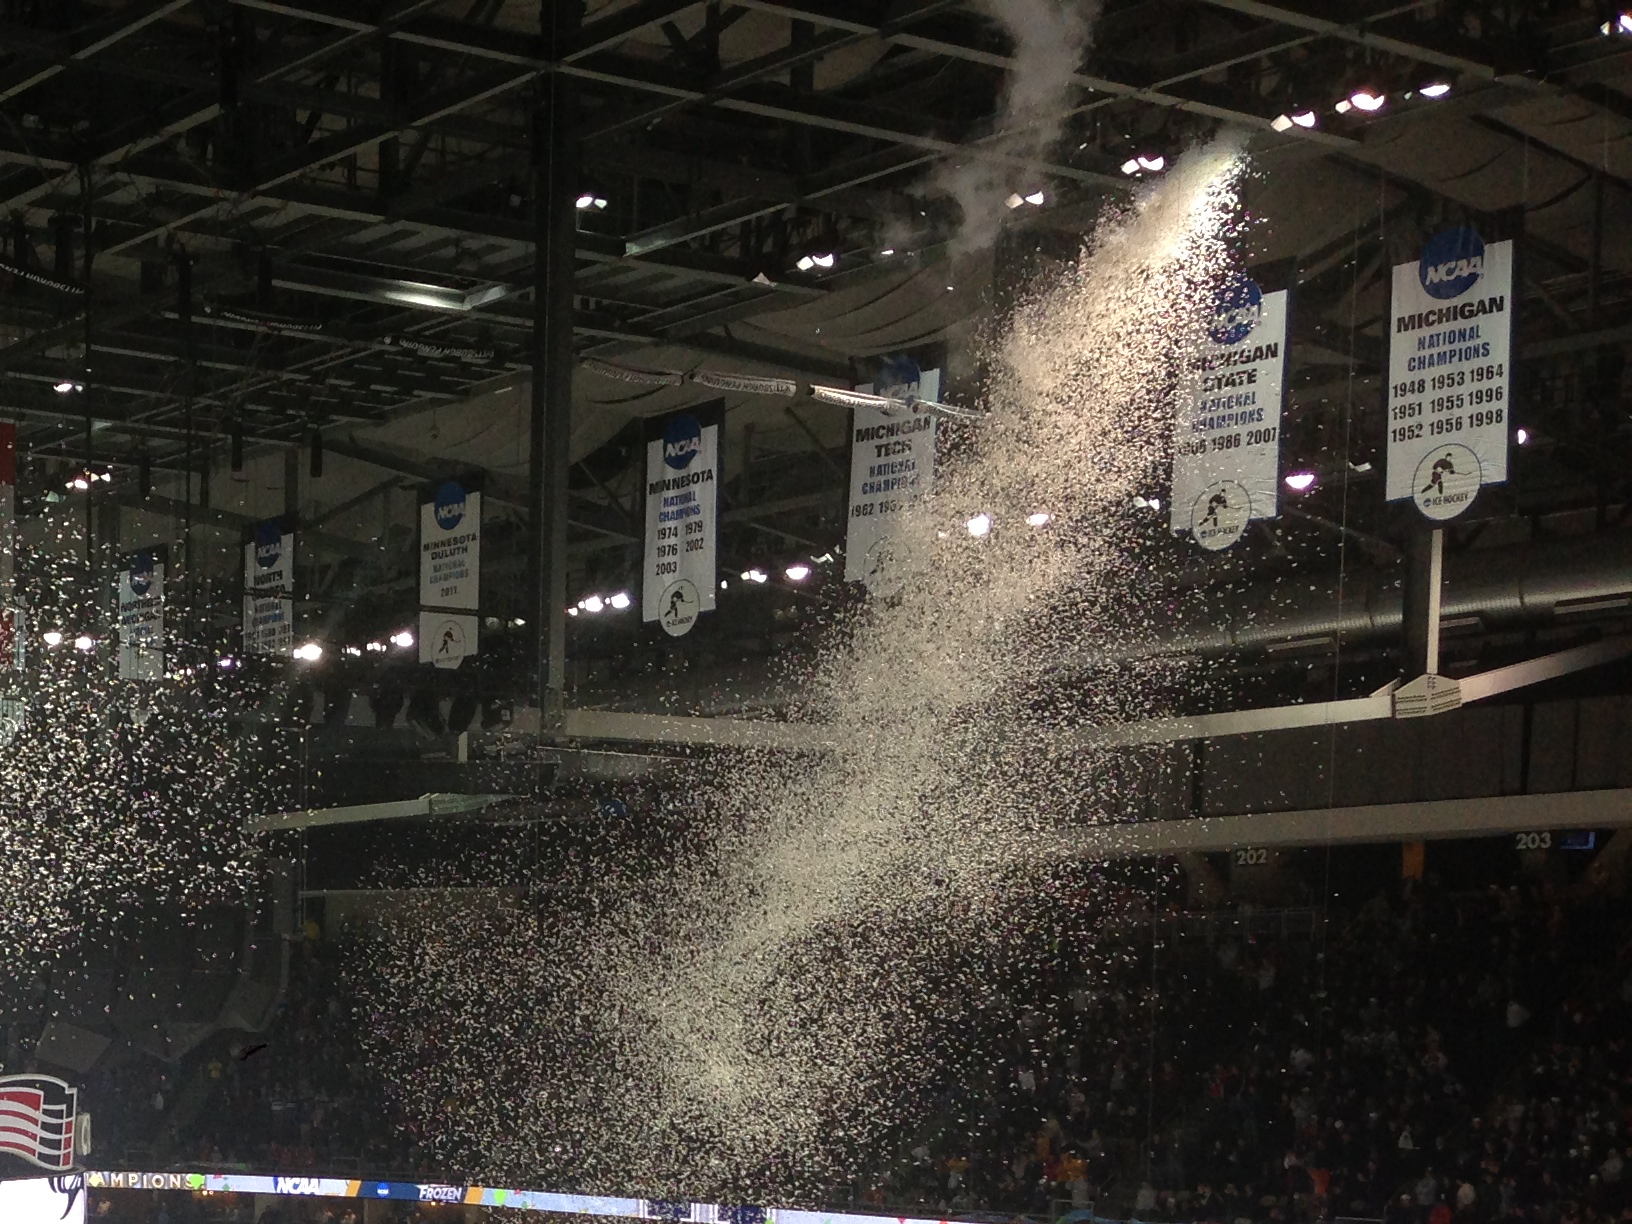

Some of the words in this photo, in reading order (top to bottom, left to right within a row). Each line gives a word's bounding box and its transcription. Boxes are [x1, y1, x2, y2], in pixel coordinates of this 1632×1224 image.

[1425, 256, 1484, 285] NCAA
[1396, 295, 1505, 334] MICHIGAN
[1417, 325, 1482, 352] NATIONAL
[1407, 342, 1491, 372] CHAMPIONS
[1201, 368, 1258, 393] STATE
[1392, 378, 1426, 399] 1948
[1430, 371, 1466, 391] 1953
[1468, 363, 1505, 383] 1964
[1391, 401, 1423, 421] 1951
[1429, 393, 1465, 414] 1955
[1467, 385, 1504, 406] 1996
[855, 416, 931, 443] MICHIGAN
[1390, 423, 1424, 443] 1952
[1429, 416, 1463, 436] 1956
[1467, 408, 1504, 429] 1998
[665, 436, 701, 458] NCAA
[874, 439, 913, 458] TECH
[1212, 433, 1241, 452] 1986
[1246, 427, 1277, 446] 2007
[648, 468, 713, 496] MINNESOTA
[663, 491, 697, 508] NATIONAL
[1443, 492, 1469, 505] HOCKEY
[658, 504, 701, 522] CHAMPIONS
[657, 525, 679, 541] 1974
[685, 520, 703, 535] 1979
[422, 532, 478, 553] MINNESOTA
[430, 545, 468, 561] DULUTH
[656, 543, 678, 558] 1976
[685, 537, 704, 552] 2002
[253, 569, 284, 587] NORTH
[655, 561, 678, 576] 2003
[440, 585, 458, 598] 2011
[1516, 831, 1552, 850] 203
[1236, 848, 1268, 866] 202
[276, 1176, 320, 1196] NCAA
[418, 1184, 462, 1200] FROZEN
